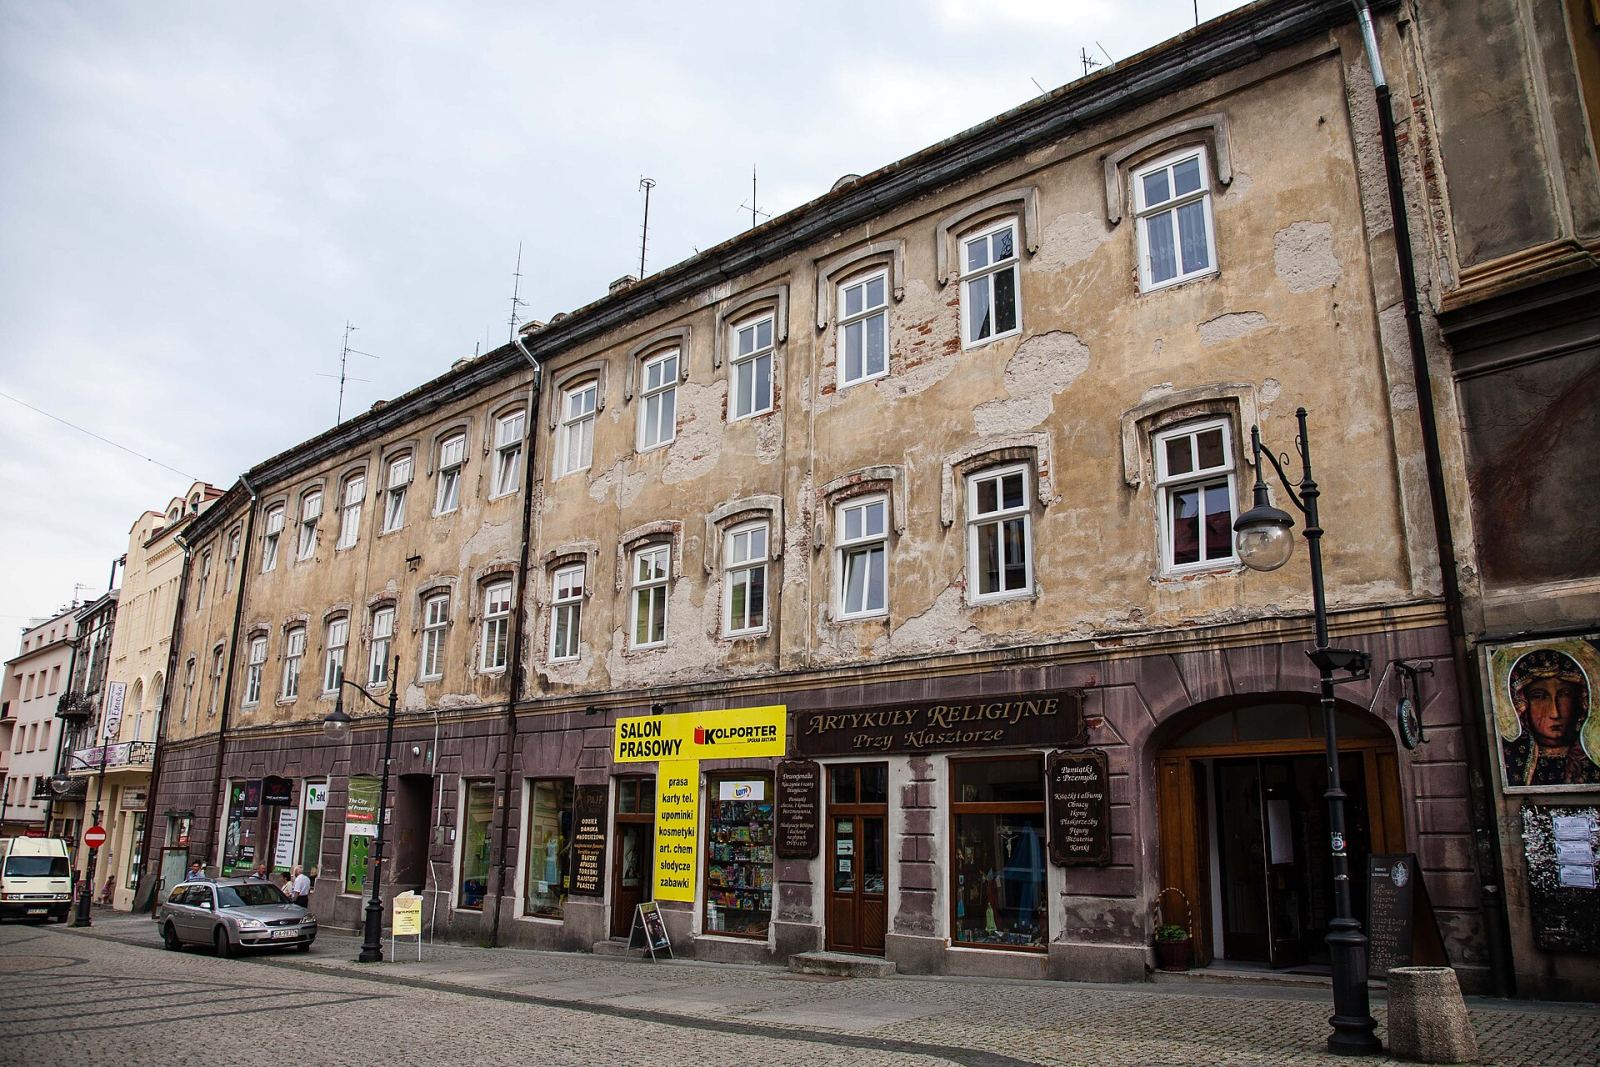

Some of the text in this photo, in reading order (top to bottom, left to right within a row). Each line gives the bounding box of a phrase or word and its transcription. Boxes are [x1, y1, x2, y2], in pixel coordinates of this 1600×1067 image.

[805, 699, 1060, 735] ARTYKUŁY RELIGIJNE
[620, 721, 662, 739] SALON
[704, 725, 777, 745] KOLPORTER
[852, 728, 1005, 751] Przy Klasztorze
[619, 739, 683, 758] PRASOWY
[668, 778, 688, 788] prasa
[662, 793, 694, 805] karty tel.
[1067, 801, 1089, 810] Obrazy
[661, 810, 694, 821] upominki
[1070, 810, 1087, 819] Ikony
[658, 826, 695, 839] kosmetyki
[1069, 827, 1089, 836] Figury
[659, 843, 693, 854] art. chem
[660, 860, 691, 872] słodycze
[660, 877, 689, 888] zabawki
